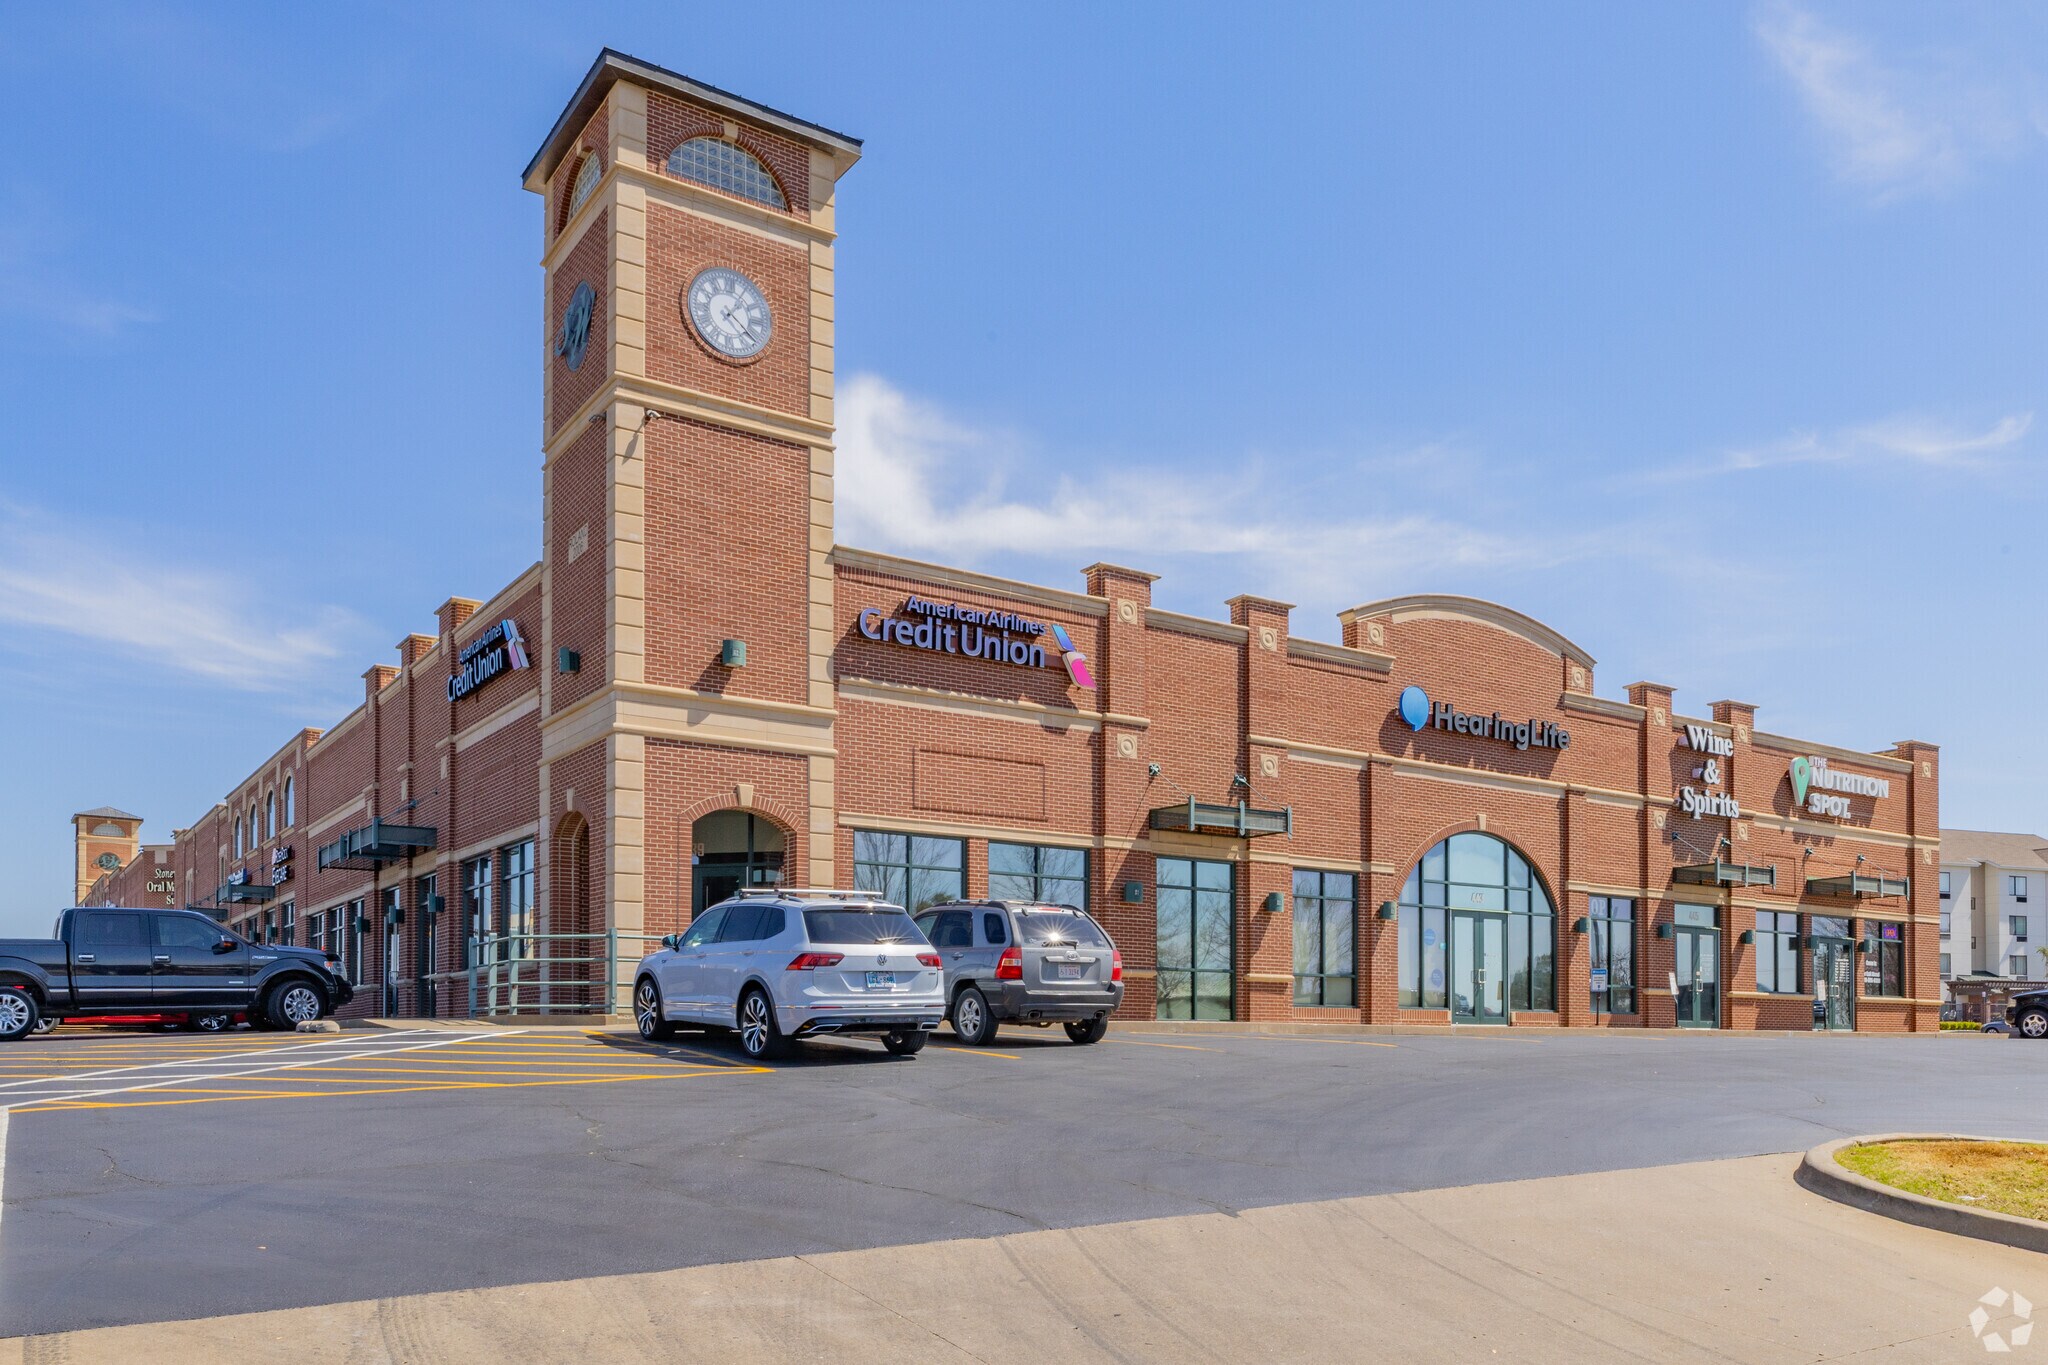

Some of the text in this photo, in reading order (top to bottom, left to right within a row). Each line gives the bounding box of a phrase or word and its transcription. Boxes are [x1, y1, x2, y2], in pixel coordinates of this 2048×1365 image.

[907, 595, 1047, 636] American Airlines
[857, 607, 1046, 669] Credit Union
[447, 648, 502, 702] Credit Union
[1432, 701, 1571, 751] HearingLife
[1684, 724, 1734, 757] Wine
[1701, 758, 1721, 785] &
[1812, 756, 1828, 769] THE
[1809, 767, 1890, 799] NUTRITION
[1680, 785, 1740, 819] Spirits
[146, 881, 165, 892] Oral
